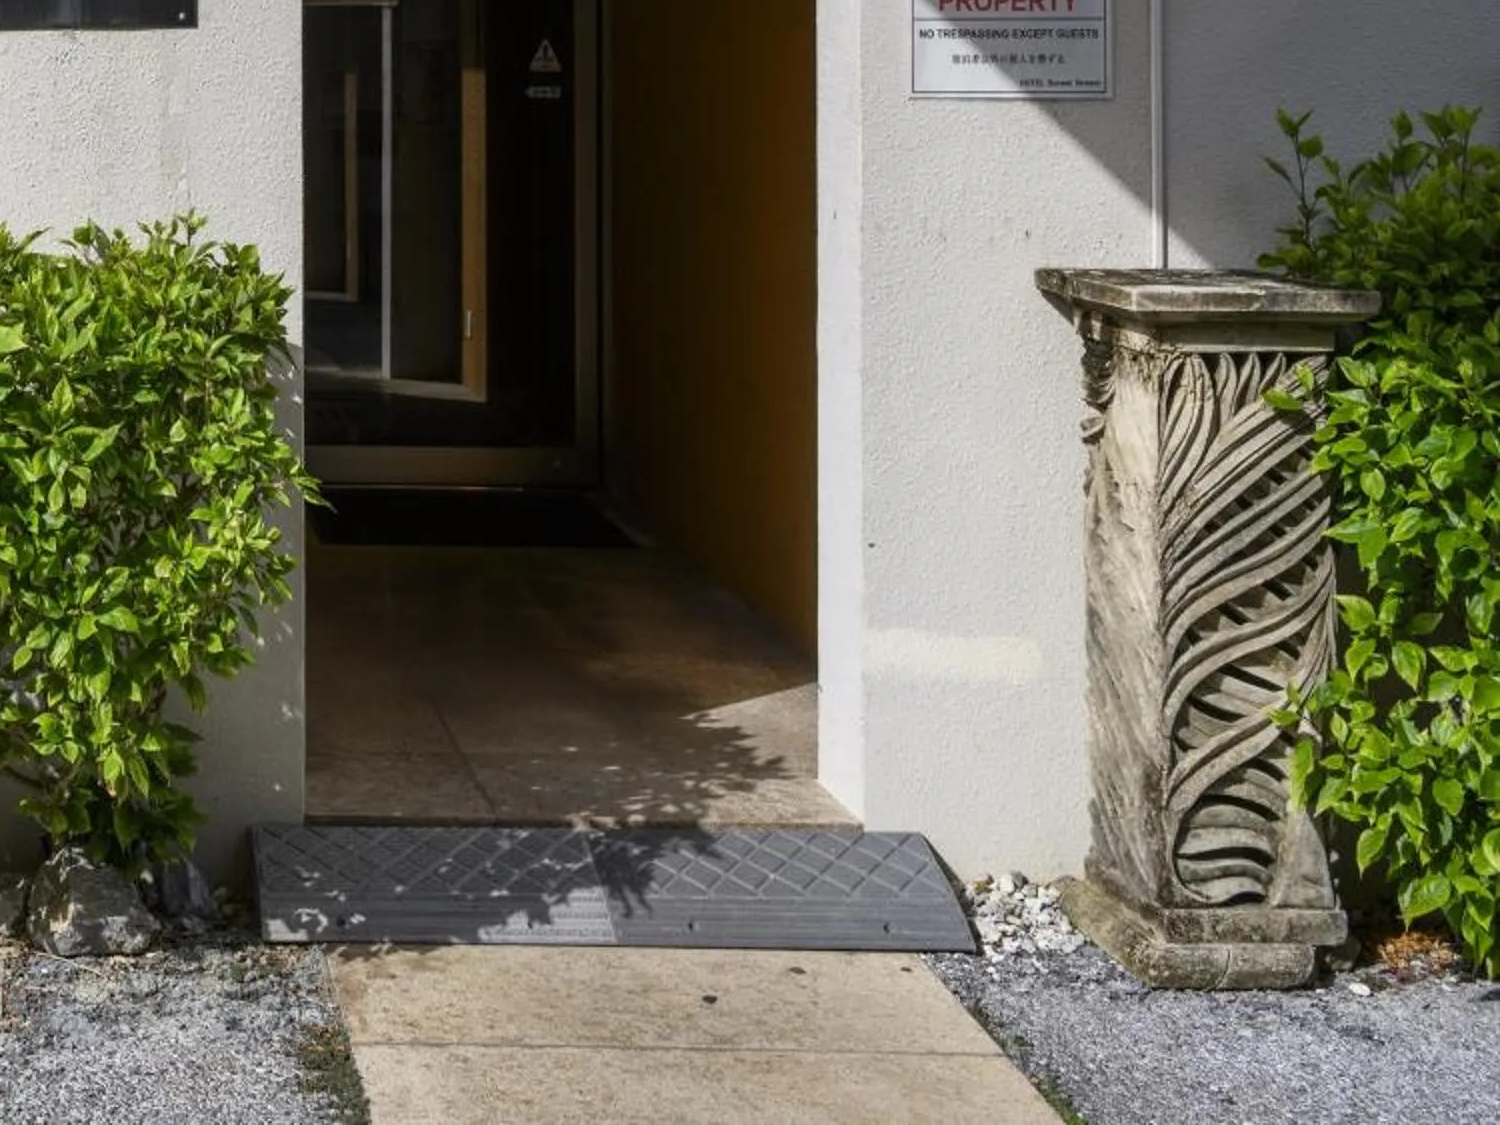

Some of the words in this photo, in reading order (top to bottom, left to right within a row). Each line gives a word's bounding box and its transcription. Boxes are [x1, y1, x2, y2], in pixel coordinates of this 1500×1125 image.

[918, 28, 935, 40] NO
[936, 28, 1010, 40] TRESPASSING
[1011, 28, 1054, 40] EXCEPT
[1055, 28, 1100, 40] GUESTS
